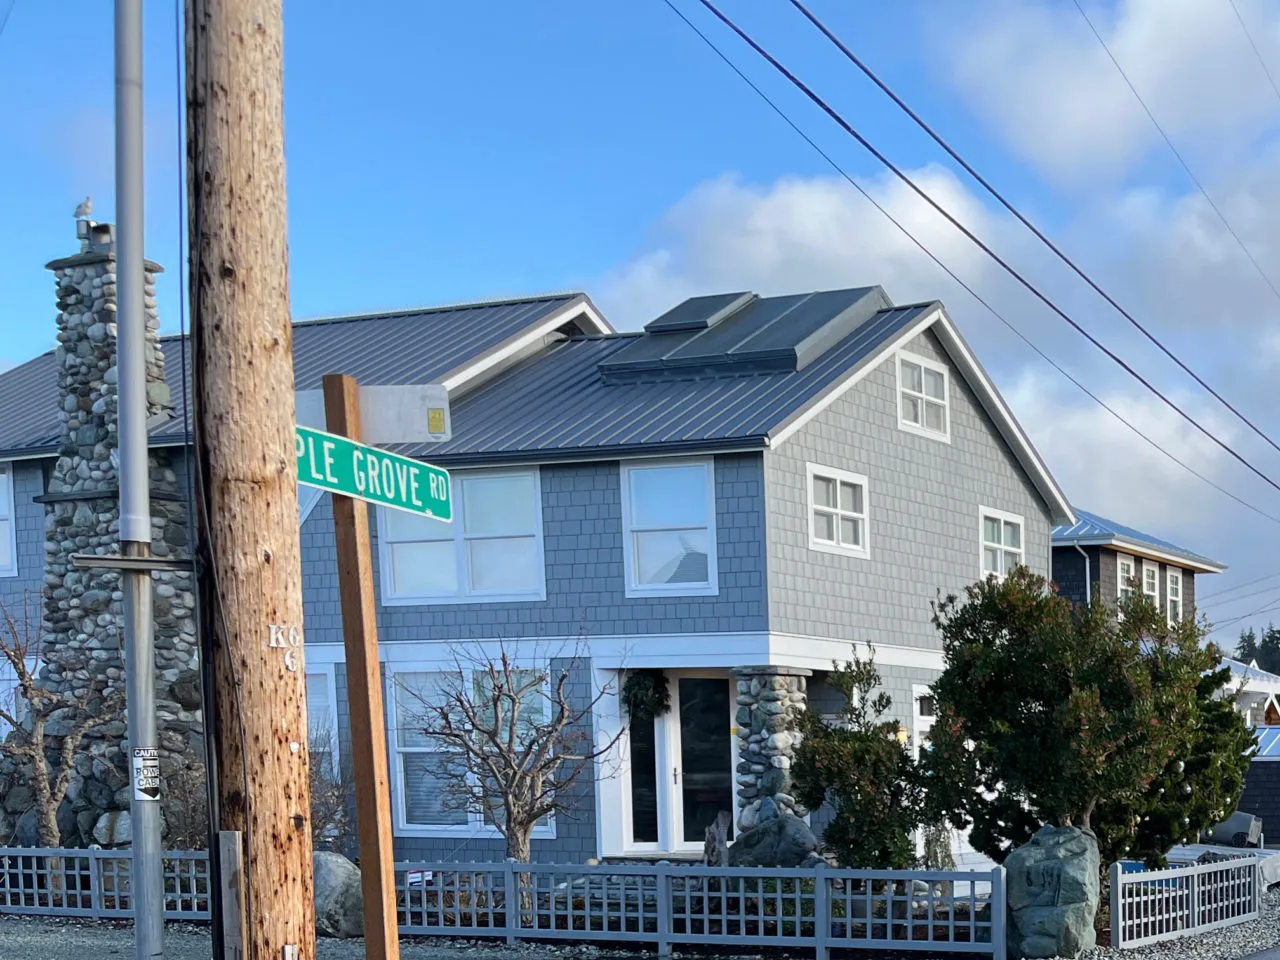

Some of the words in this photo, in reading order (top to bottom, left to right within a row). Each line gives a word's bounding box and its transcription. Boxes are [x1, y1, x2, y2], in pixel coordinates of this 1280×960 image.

[296, 433, 338, 484] PLE
[353, 450, 422, 507] GROVE
[429, 472, 446, 501] RD
